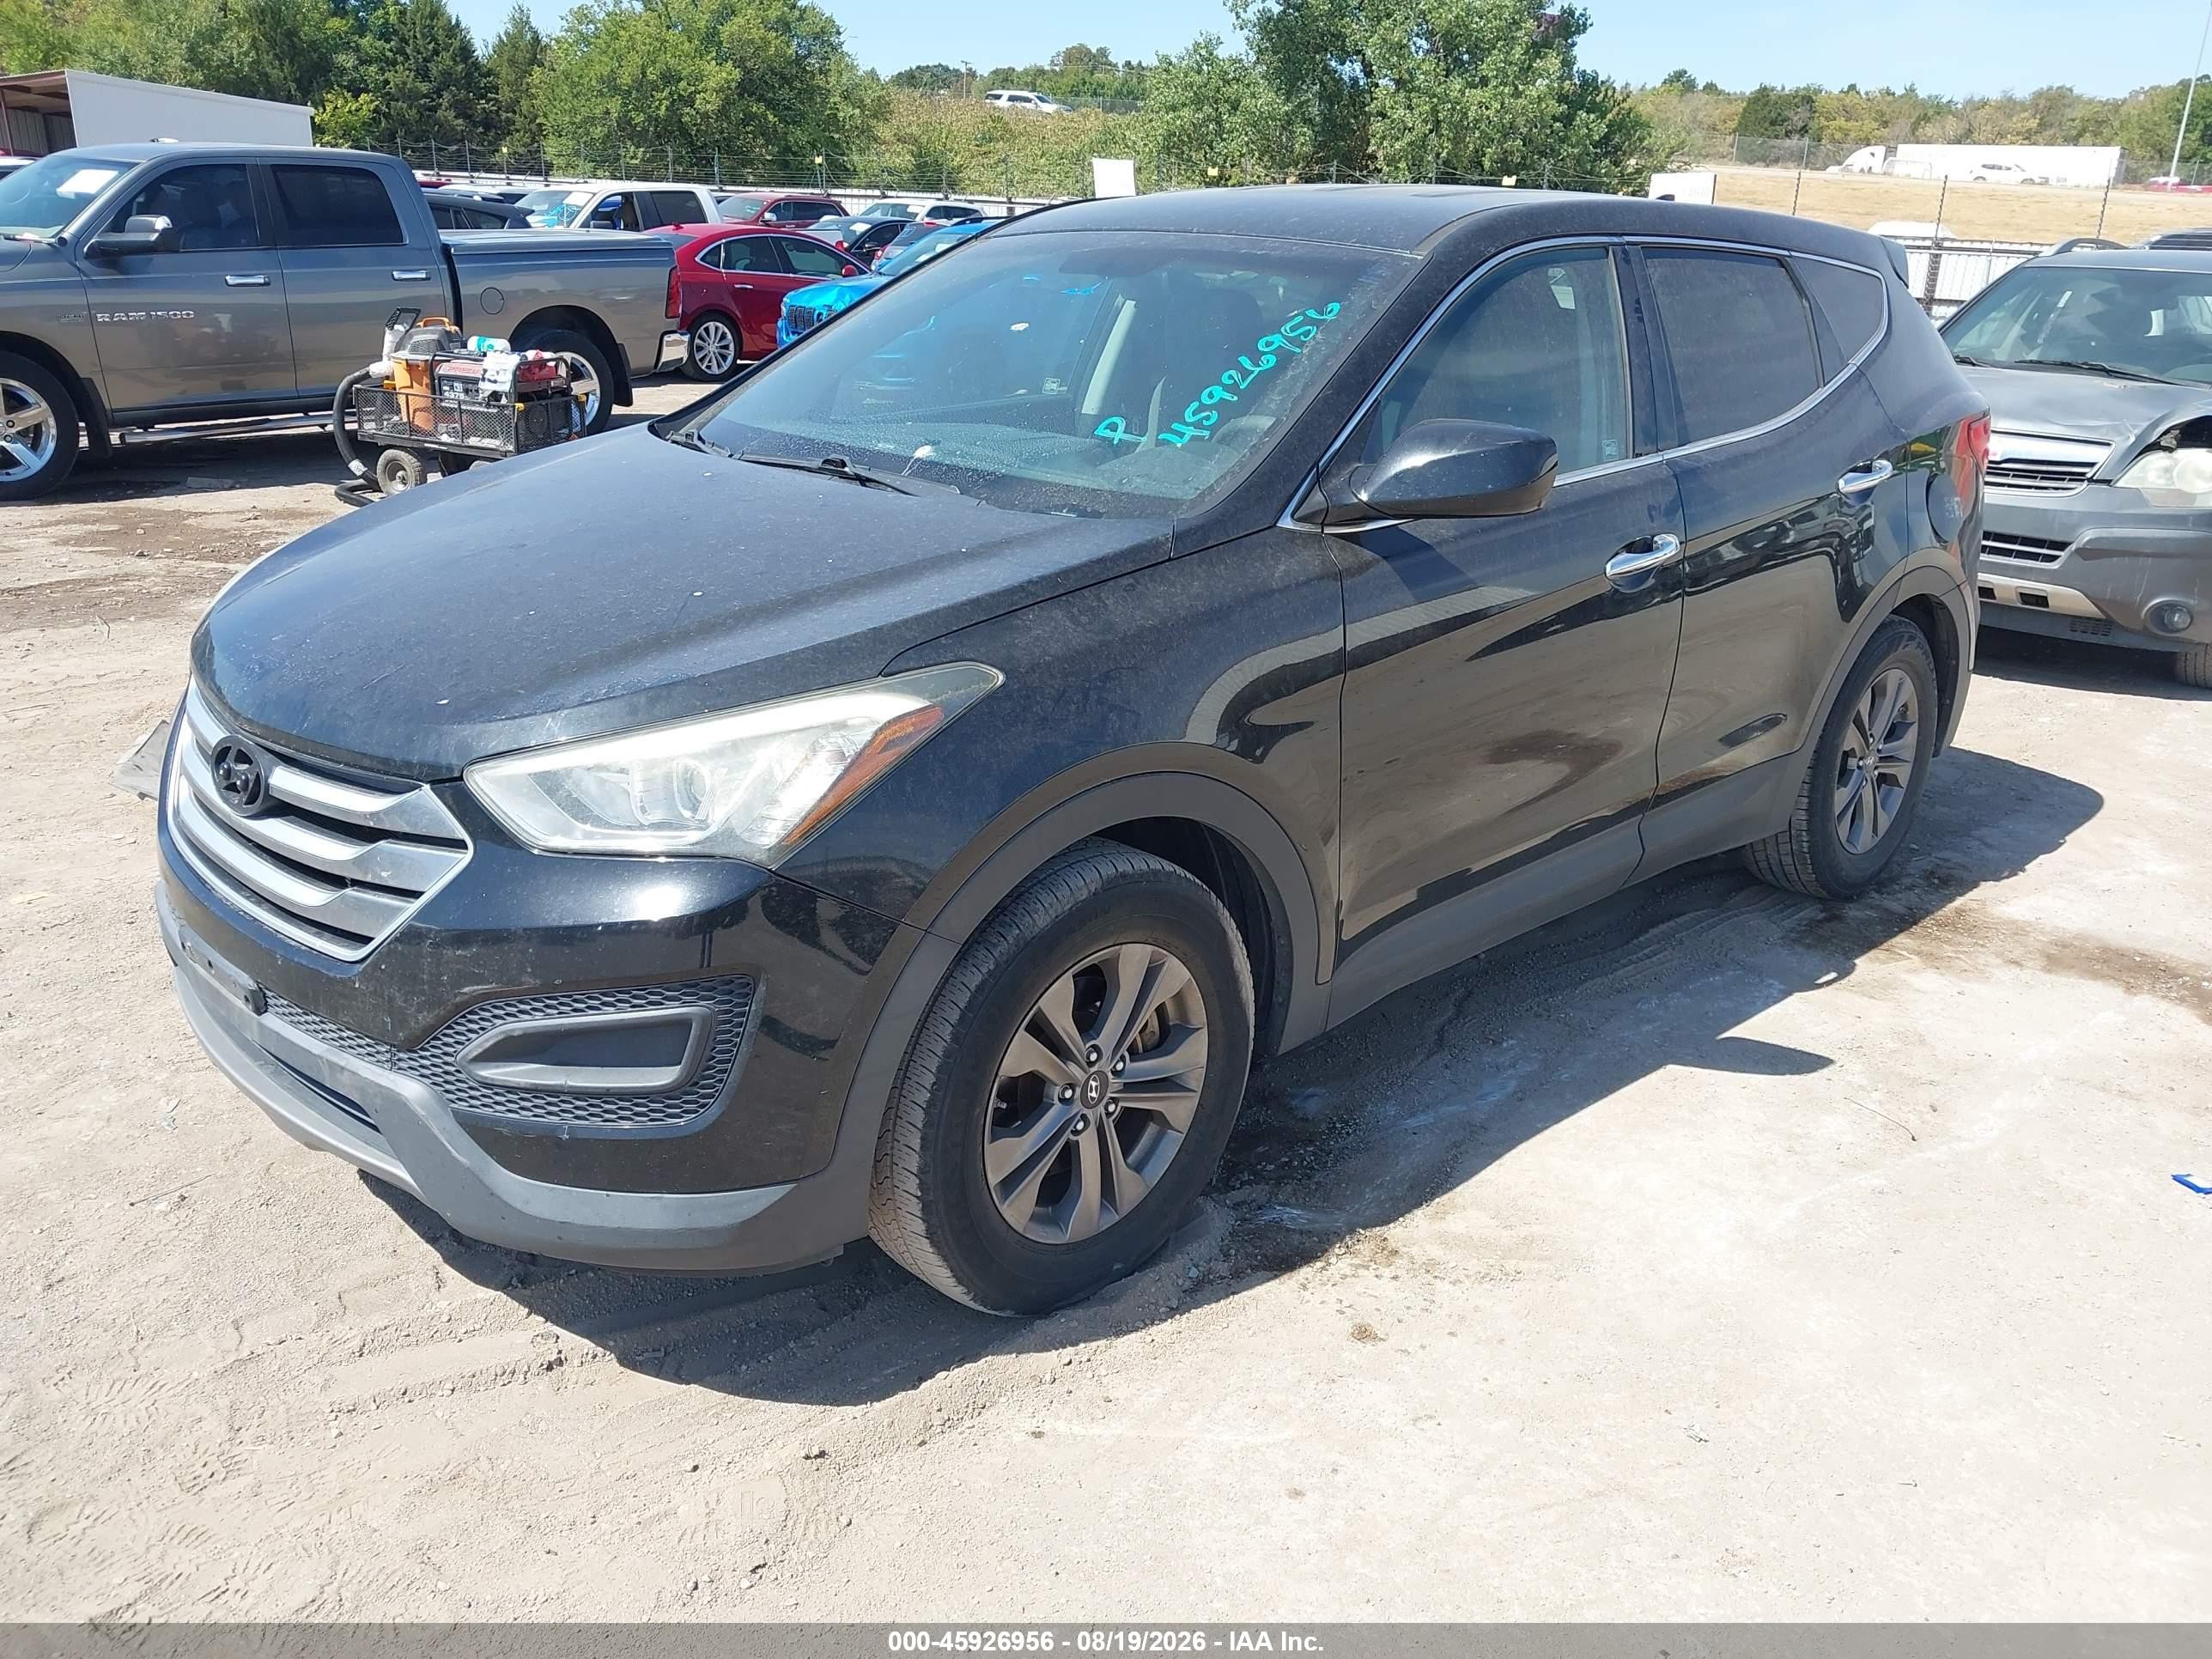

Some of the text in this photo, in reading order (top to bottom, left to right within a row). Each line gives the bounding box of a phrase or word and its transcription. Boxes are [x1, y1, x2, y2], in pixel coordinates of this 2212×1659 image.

[95, 311, 146, 322] RAM
[149, 310, 195, 320] 1500
[1158, 302, 1340, 447] 45926956
